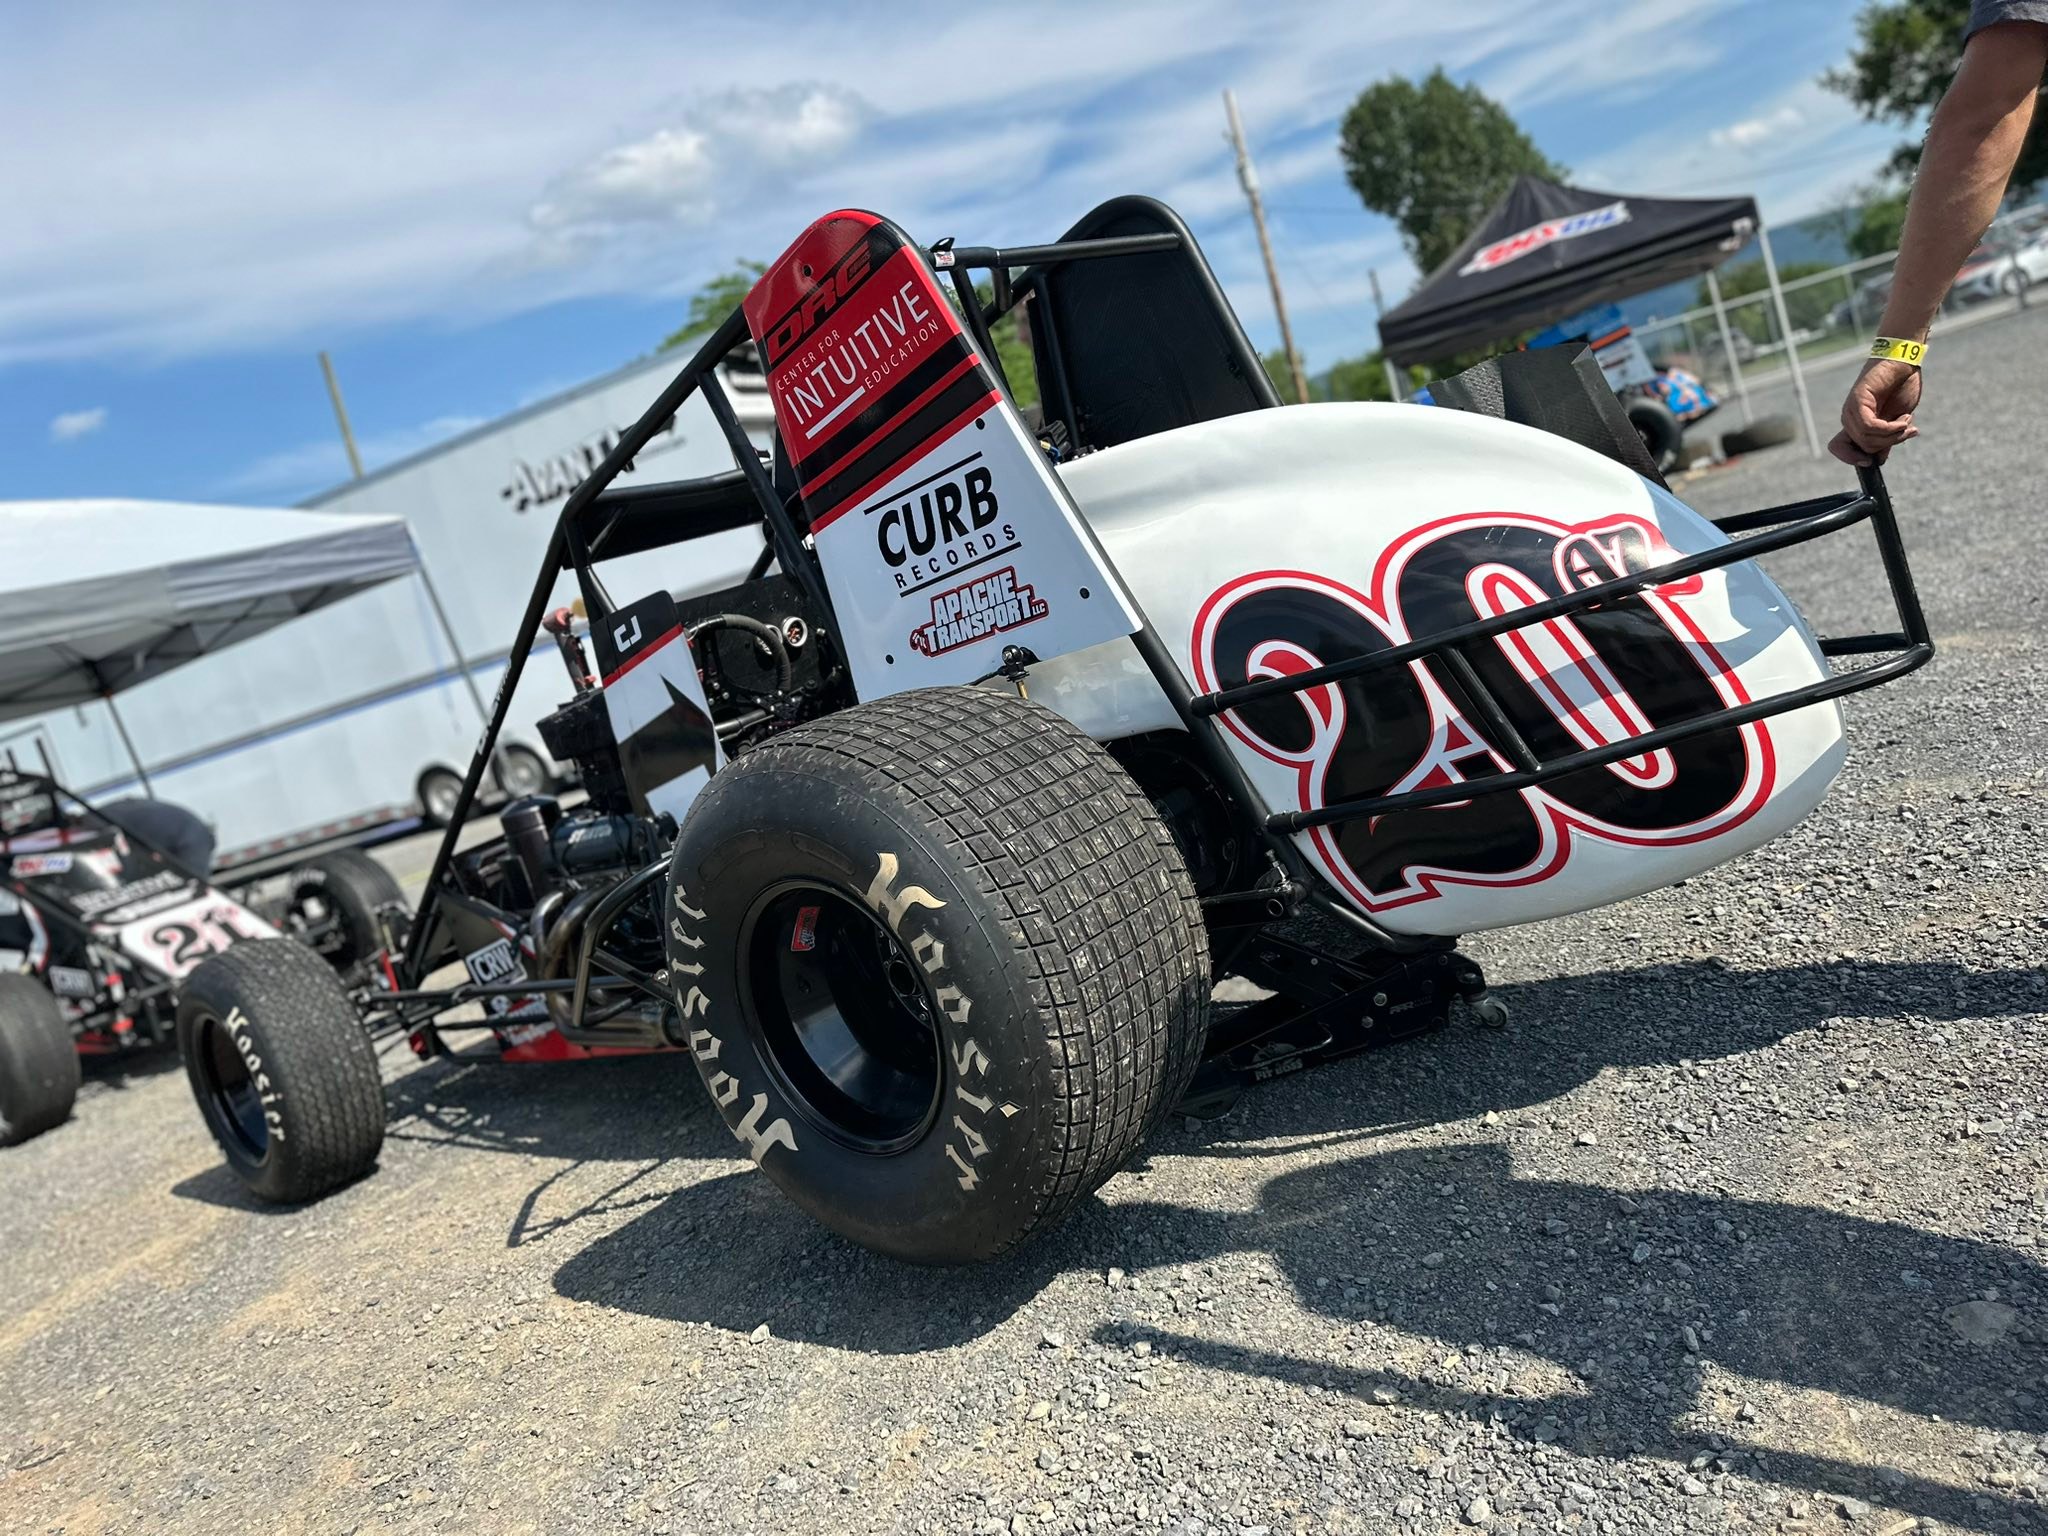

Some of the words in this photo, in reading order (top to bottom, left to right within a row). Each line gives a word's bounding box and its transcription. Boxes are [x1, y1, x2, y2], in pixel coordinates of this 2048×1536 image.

[777, 351, 817, 391] CENTER
[818, 329, 841, 353] FOR
[785, 280, 930, 425] INTUITIVE
[864, 319, 940, 390] EDUCATION
[1900, 343, 1921, 361] 19
[877, 466, 999, 568] CURB
[894, 524, 1016, 589] RECORDS
[923, 588, 1032, 654] TRANSPORT
[1032, 602, 1046, 616] LLC
[932, 569, 1016, 628] APACHE
[613, 615, 643, 653] CJ
[1202, 516, 1762, 905] 20
[474, 946, 518, 984] CRW
